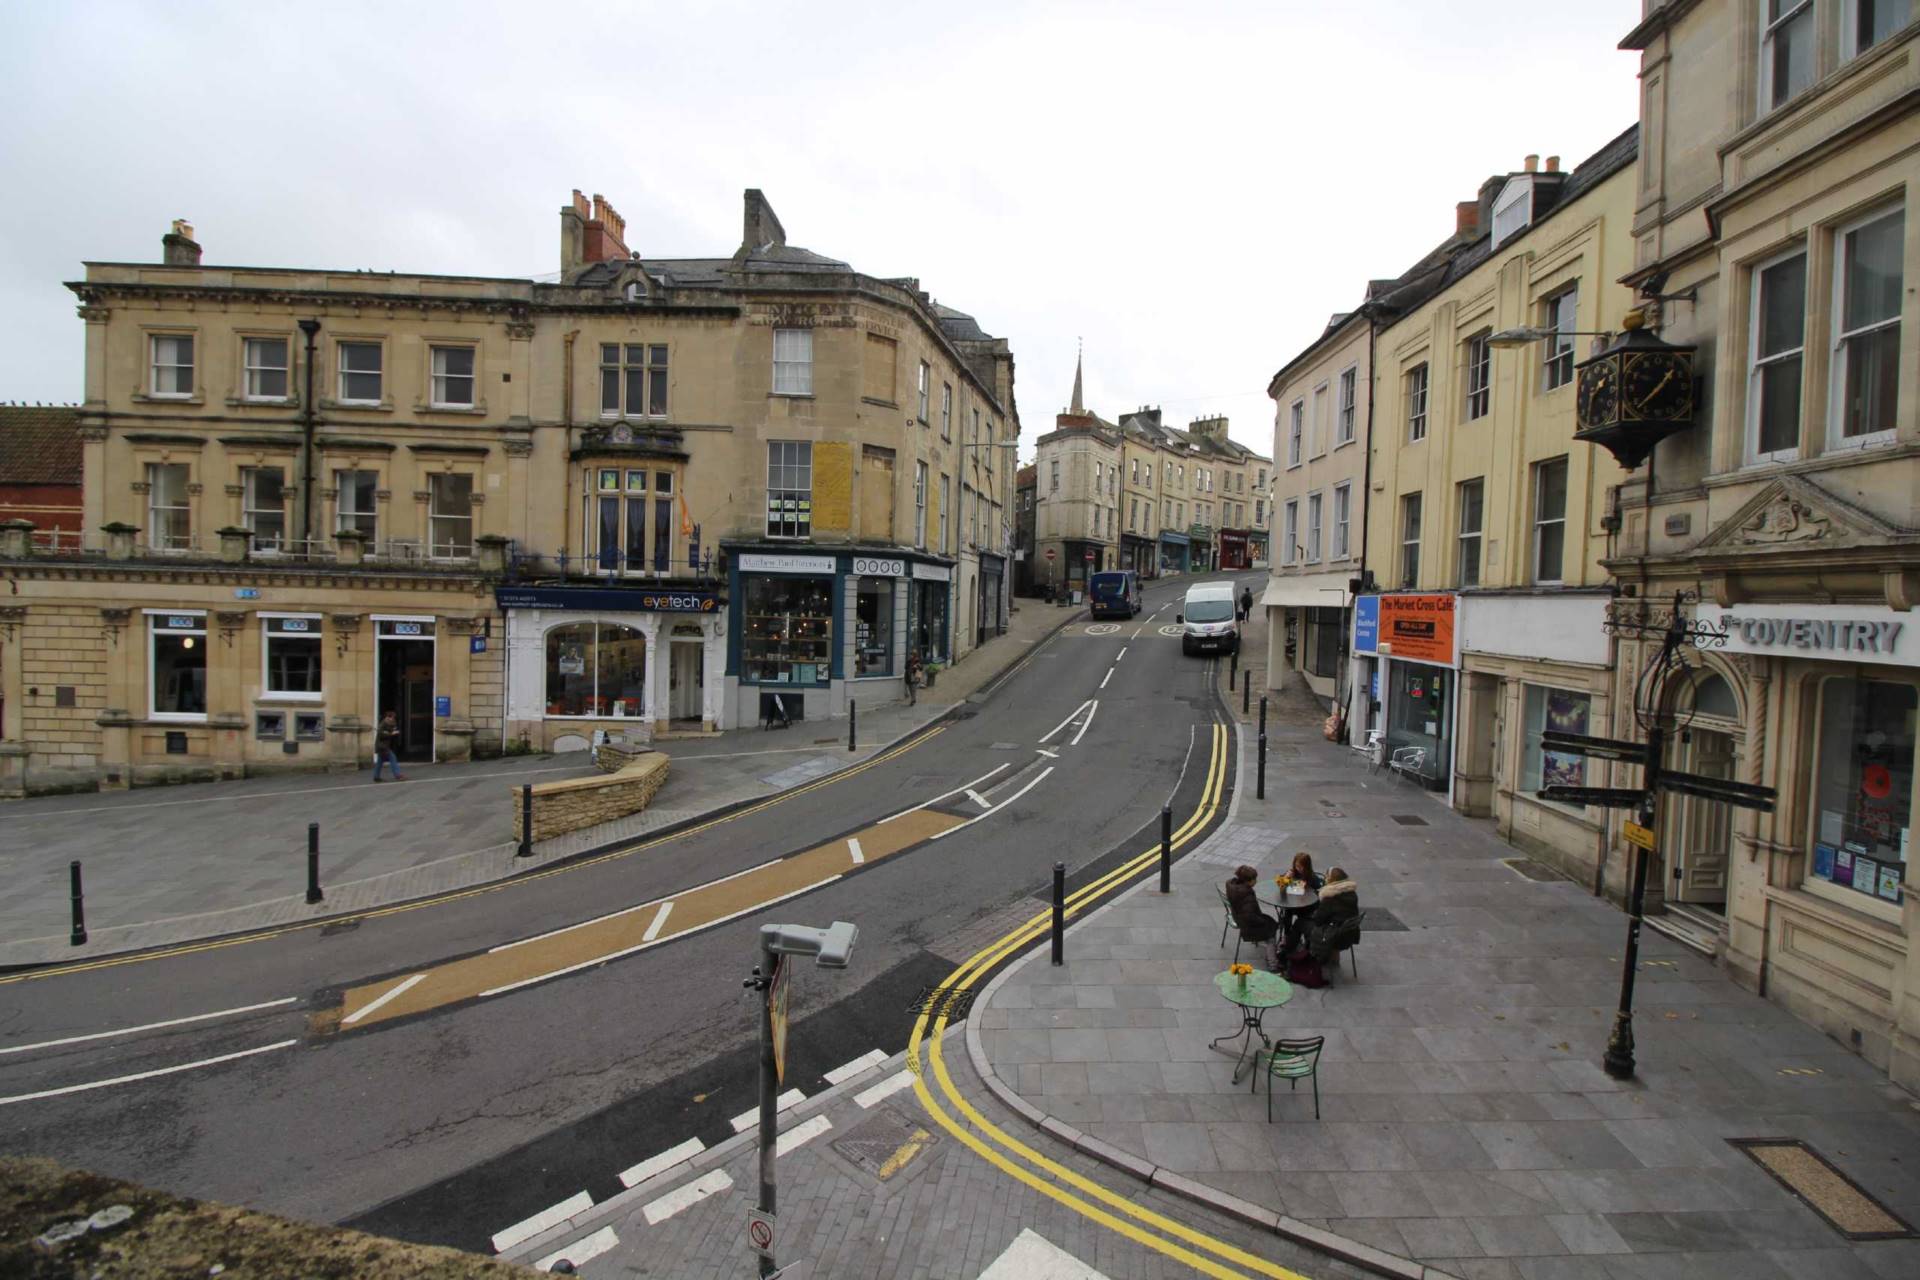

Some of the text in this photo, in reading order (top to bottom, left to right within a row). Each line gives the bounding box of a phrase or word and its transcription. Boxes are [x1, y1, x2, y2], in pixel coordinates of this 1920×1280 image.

[643, 595, 700, 609] eyetech
[1381, 598, 1393, 610] The
[1394, 597, 1415, 610] Market
[1416, 598, 1435, 611] Cross
[1741, 617, 1903, 653] COVENTRY
